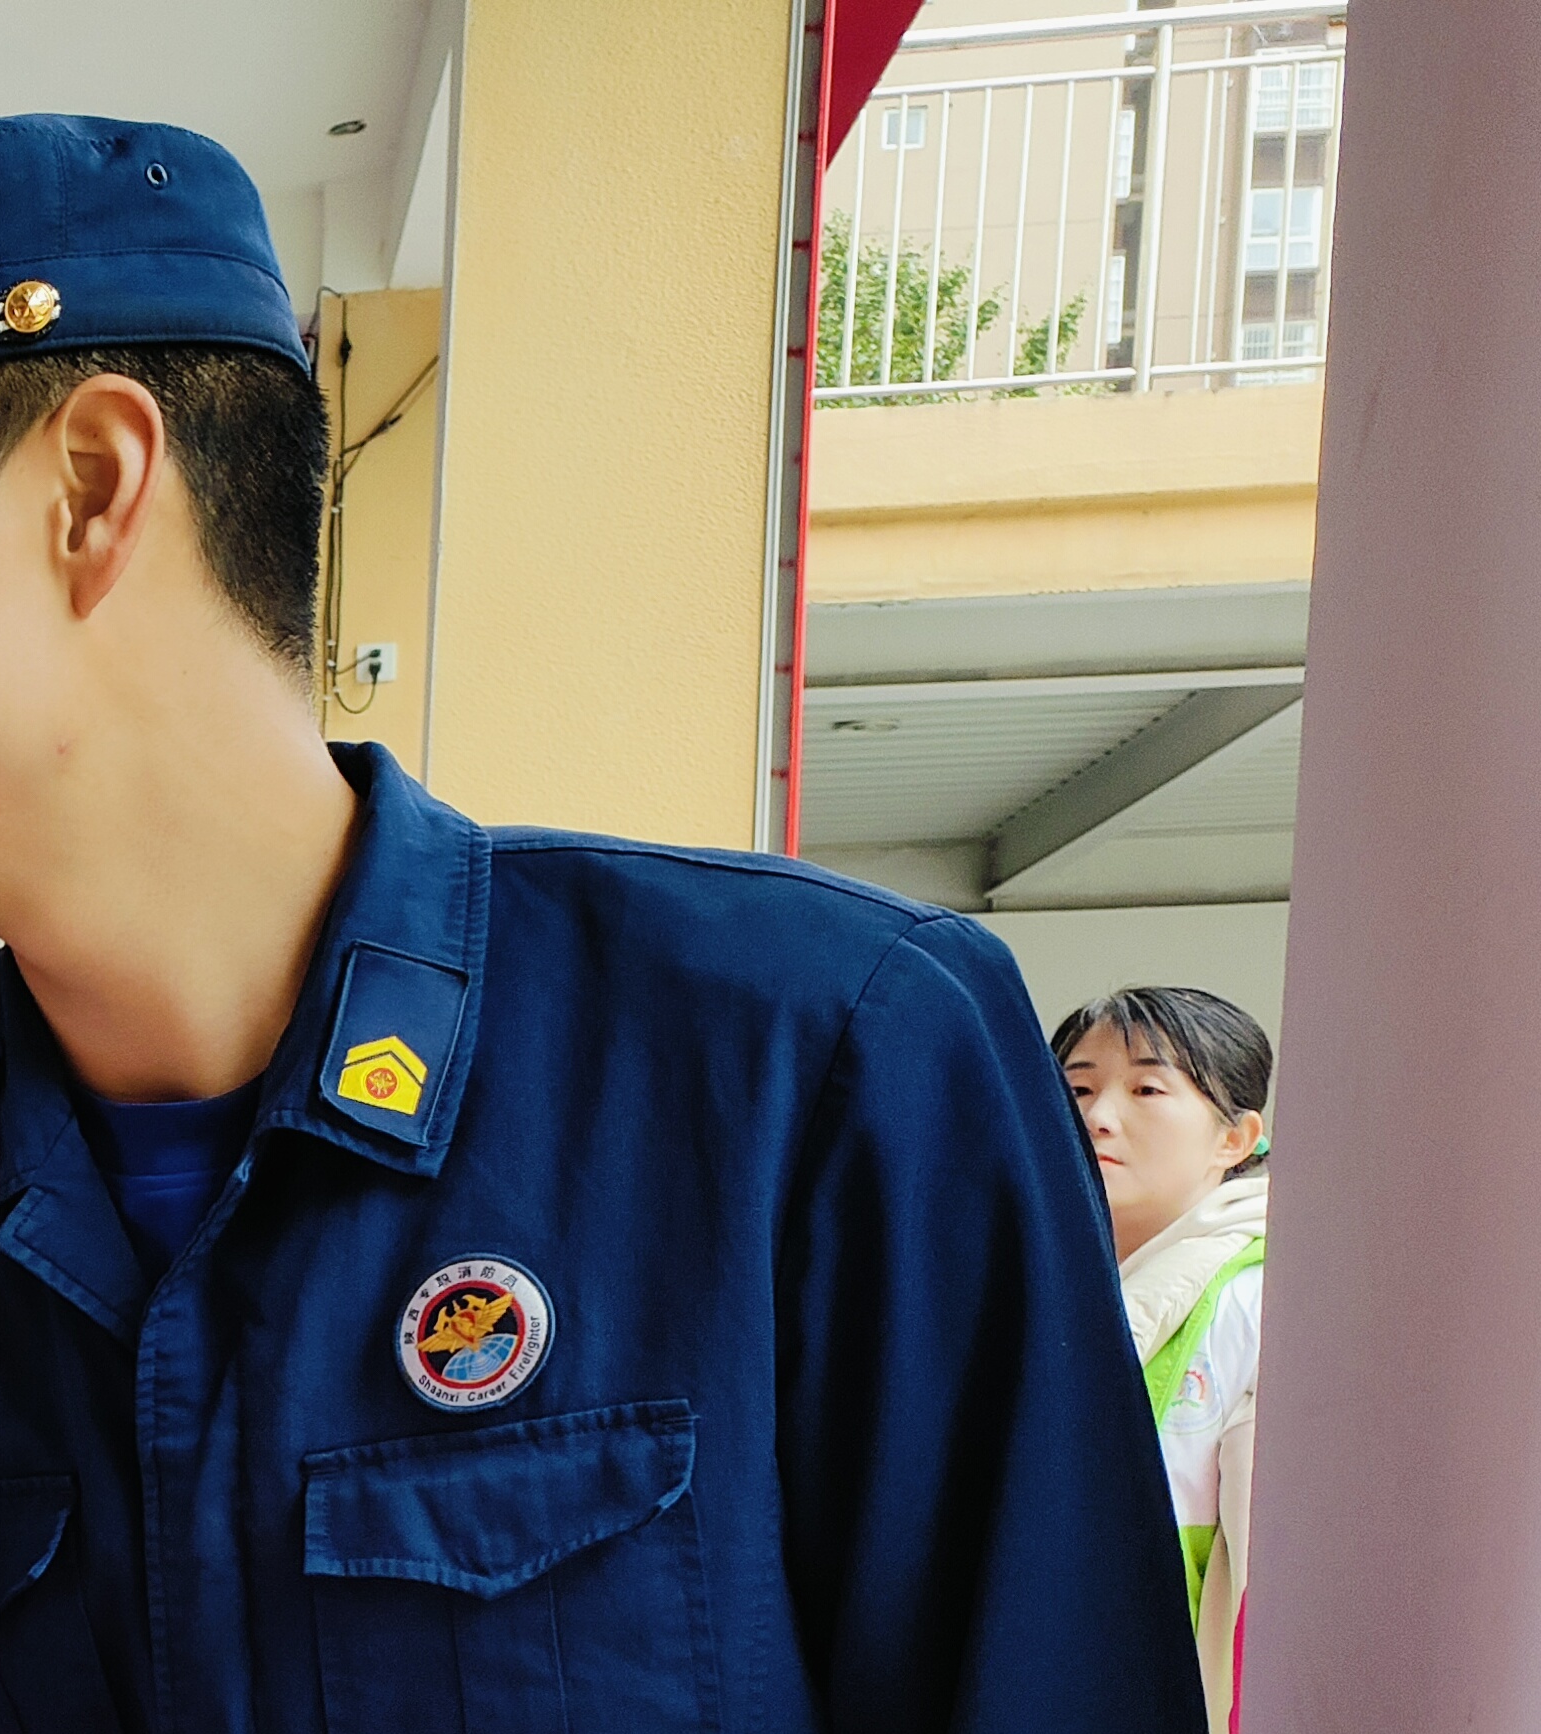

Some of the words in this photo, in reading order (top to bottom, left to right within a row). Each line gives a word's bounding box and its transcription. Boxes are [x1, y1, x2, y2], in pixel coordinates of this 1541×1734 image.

[418, 1374, 459, 1403] Shaanxi
[467, 1381, 507, 1402] Career
[510, 1315, 541, 1381] Firefighter
